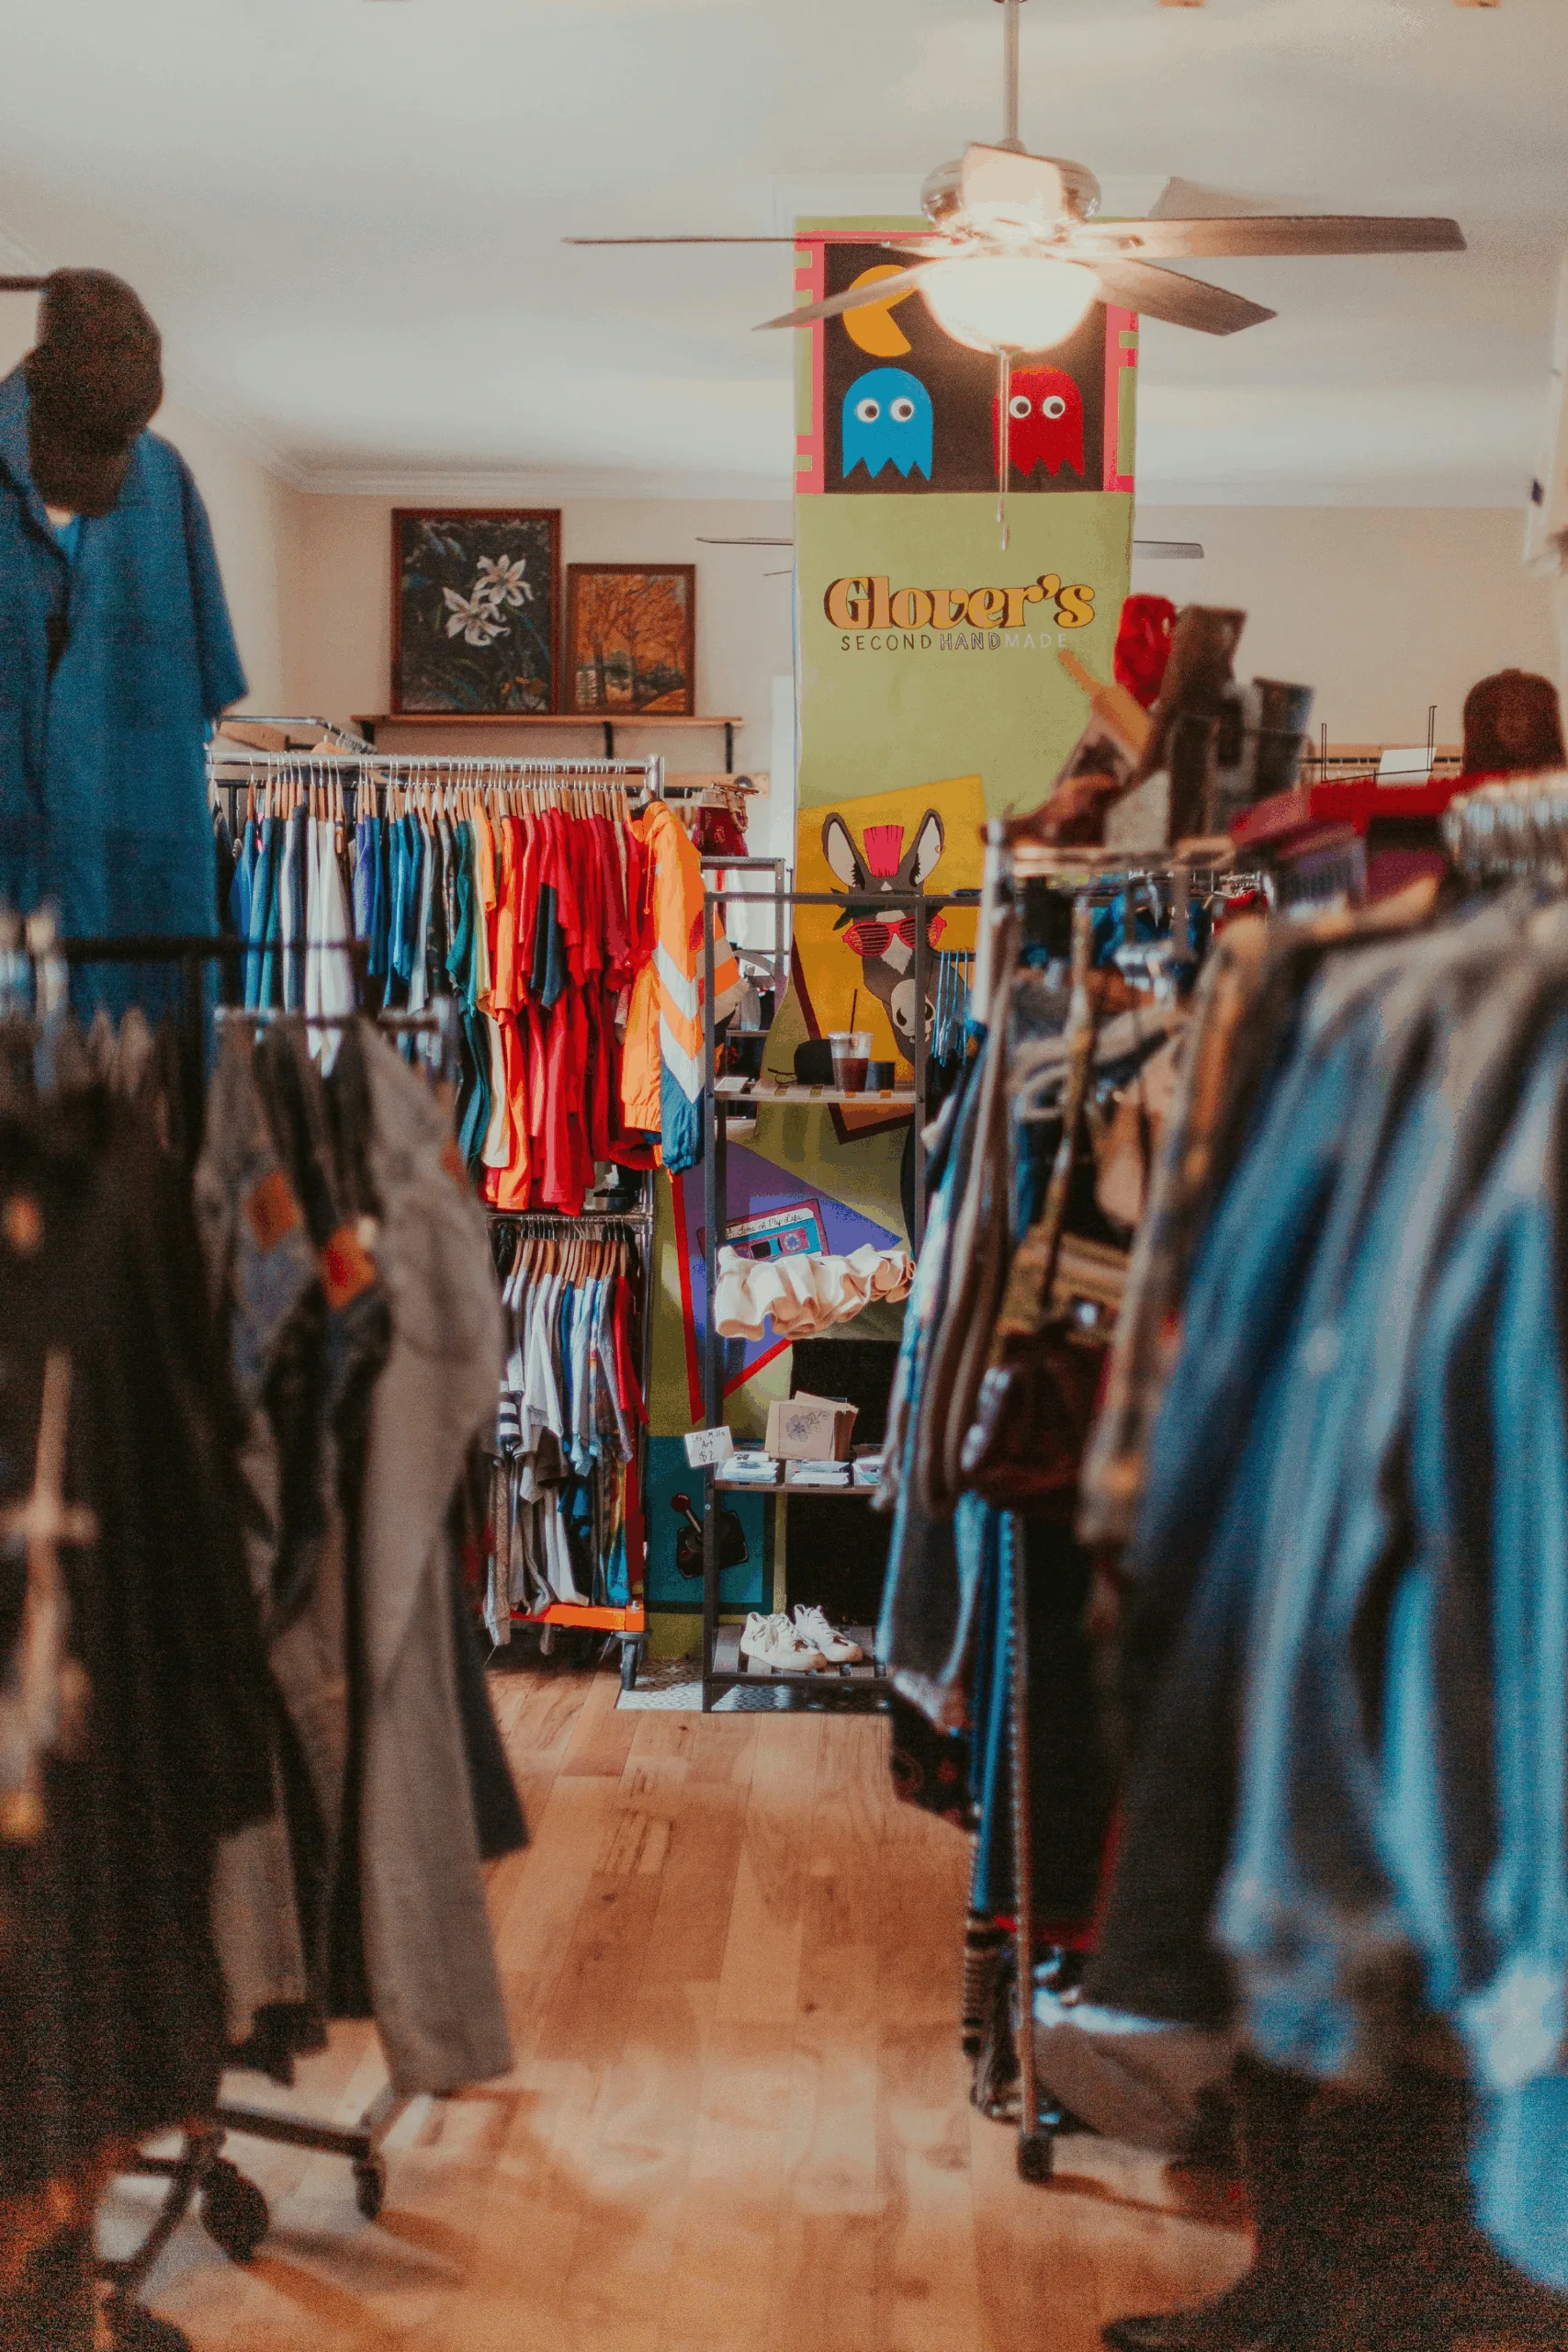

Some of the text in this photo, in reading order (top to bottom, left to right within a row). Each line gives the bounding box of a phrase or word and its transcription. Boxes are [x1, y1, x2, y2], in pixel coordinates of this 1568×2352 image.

[824, 572, 1095, 630] Glover's
[840, 634, 932, 651] SECOND
[769, 1218, 783, 1227] My
[784, 1214, 803, 1223] Life
[702, 1440, 714, 1449] Art
[699, 1451, 716, 1463] $2
